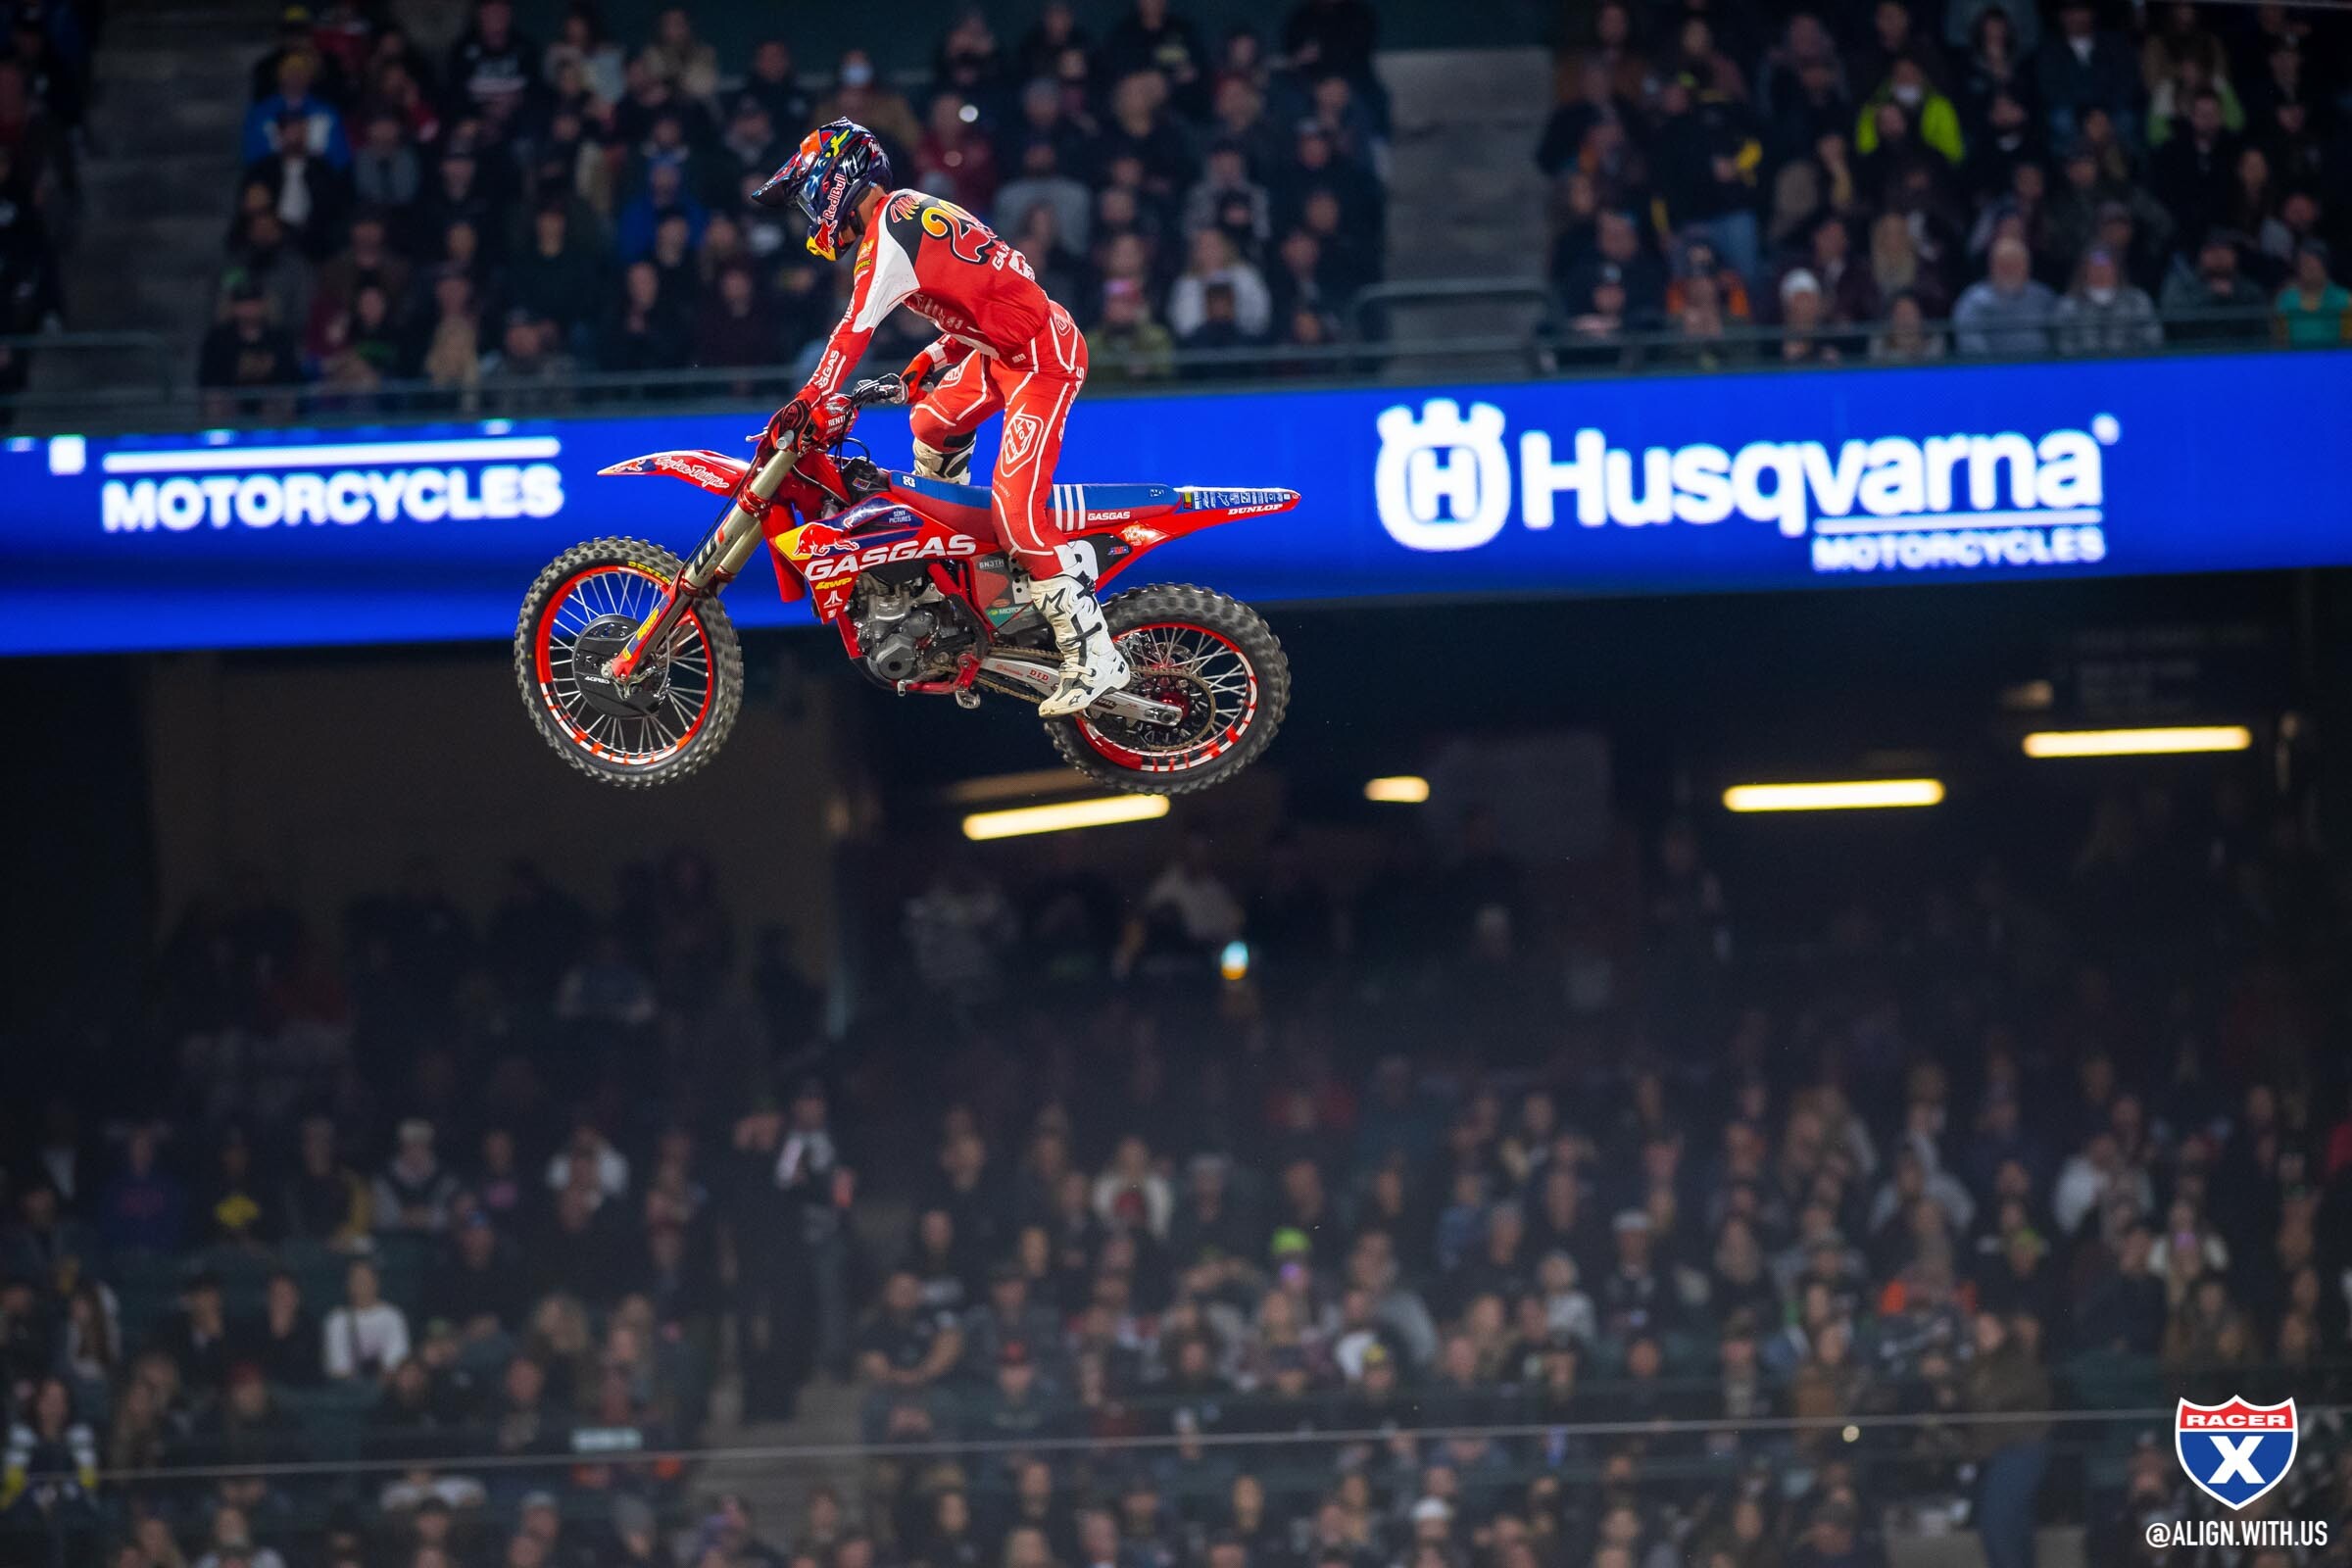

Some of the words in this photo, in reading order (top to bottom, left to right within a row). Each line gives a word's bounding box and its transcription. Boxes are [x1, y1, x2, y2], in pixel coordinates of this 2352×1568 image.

[102, 465, 564, 533] MOTORCYCLES
[1521, 427, 2103, 537] Husqvarna
[1088, 511, 1130, 520] GASGAS
[1227, 503, 1284, 515] DUNLOP
[804, 534, 976, 581] GASGAS
[1812, 526, 2106, 572] MOTORCYCLES
[627, 561, 672, 585] DUNLO
[1030, 669, 1050, 681] DID
